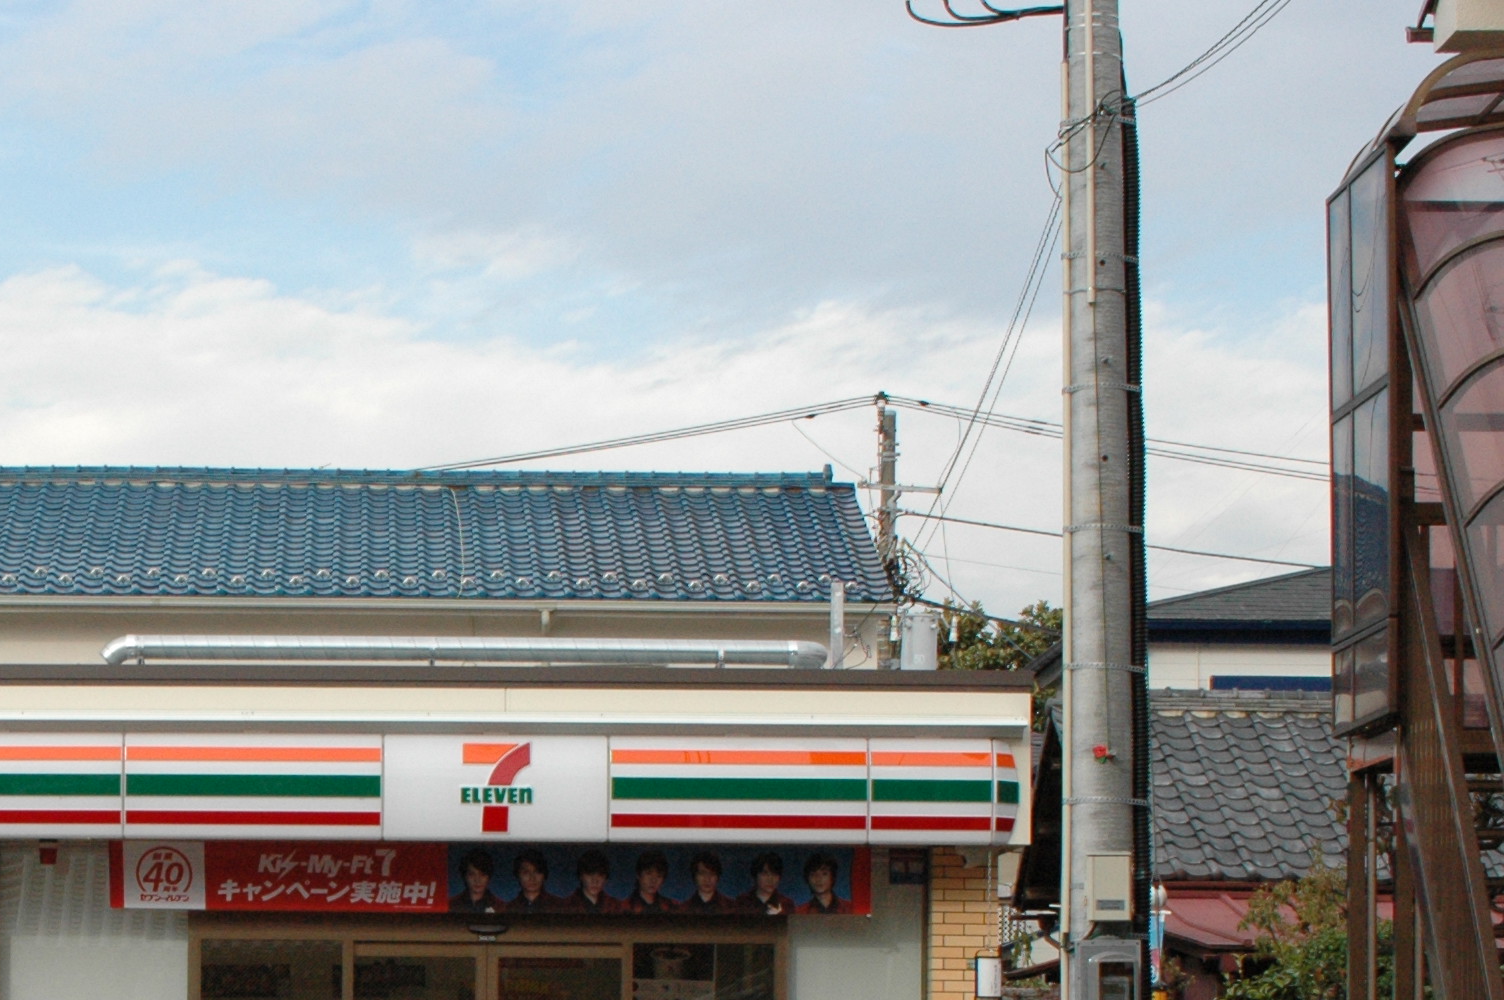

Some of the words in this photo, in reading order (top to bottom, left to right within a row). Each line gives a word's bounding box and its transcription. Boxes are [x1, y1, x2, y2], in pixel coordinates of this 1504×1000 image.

[143, 861, 184, 892] 40
[217, 879, 437, 905] キャンペーン実施中!
